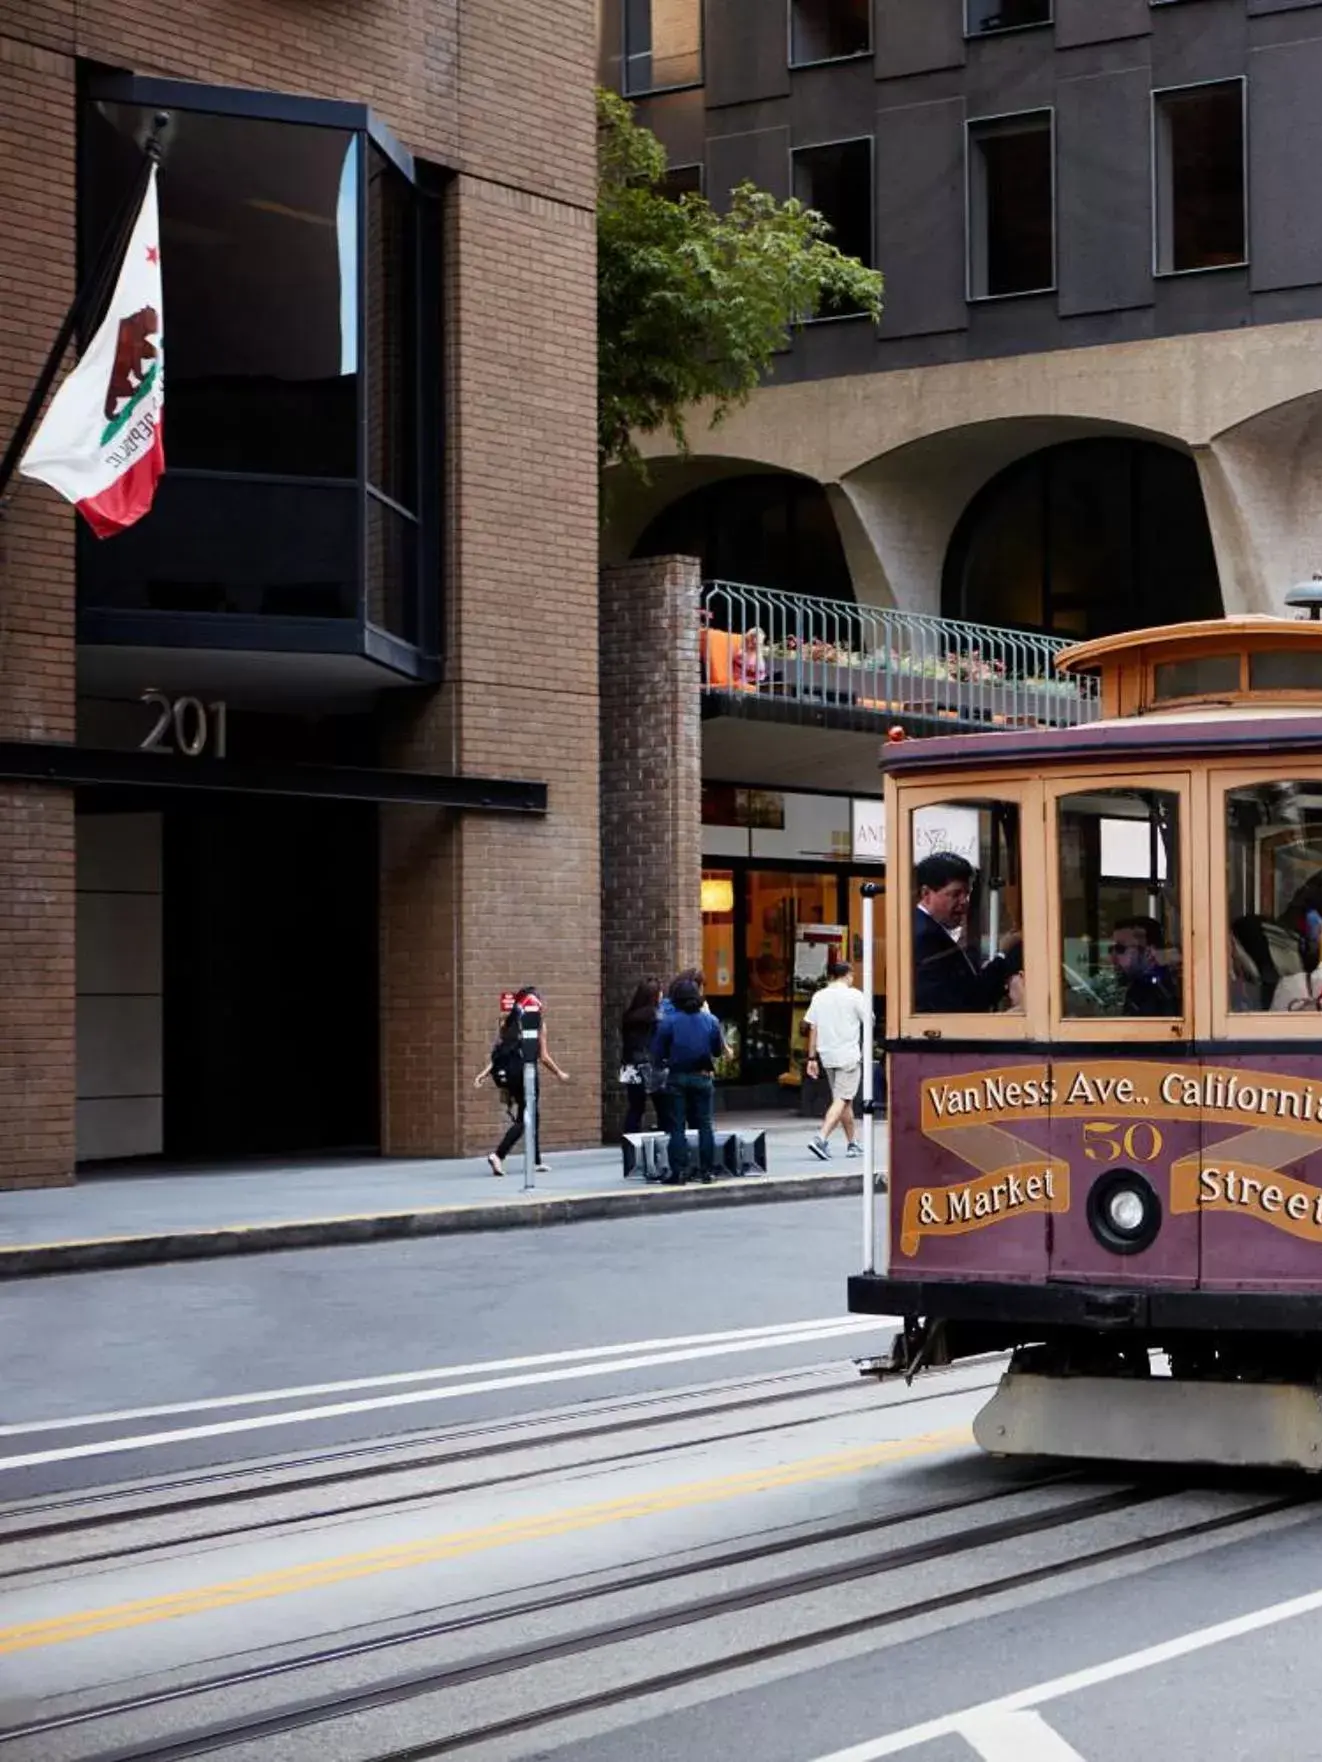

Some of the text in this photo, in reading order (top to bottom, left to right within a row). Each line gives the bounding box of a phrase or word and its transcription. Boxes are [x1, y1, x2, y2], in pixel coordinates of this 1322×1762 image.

[139, 688, 226, 759] 201
[1083, 1121, 1163, 1162] 50
[918, 1192, 942, 1225] &
[945, 1168, 1056, 1225] Market
